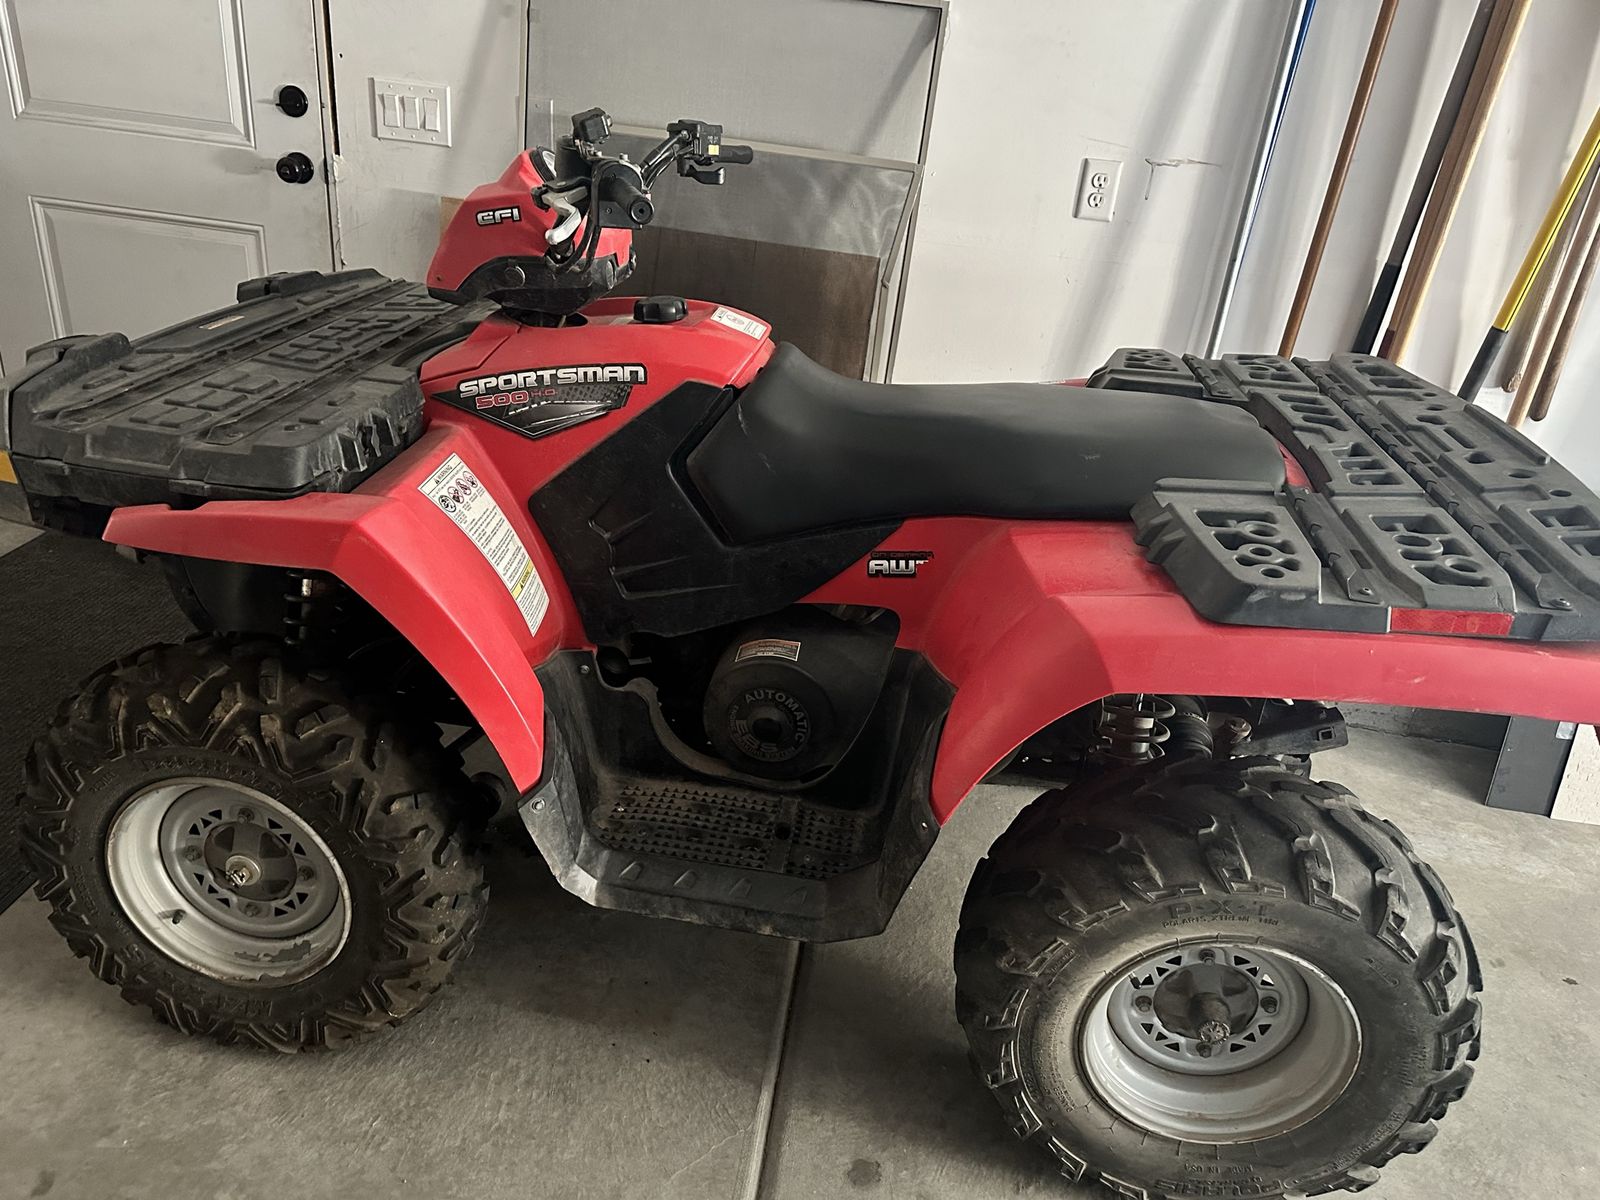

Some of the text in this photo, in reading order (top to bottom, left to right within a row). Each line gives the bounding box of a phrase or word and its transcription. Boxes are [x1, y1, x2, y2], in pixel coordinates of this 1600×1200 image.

[459, 365, 646, 399] SPORTSMAN
[475, 390, 529, 410] 500
[868, 559, 929, 575] AW
[744, 689, 808, 744] AUTOMATIC
